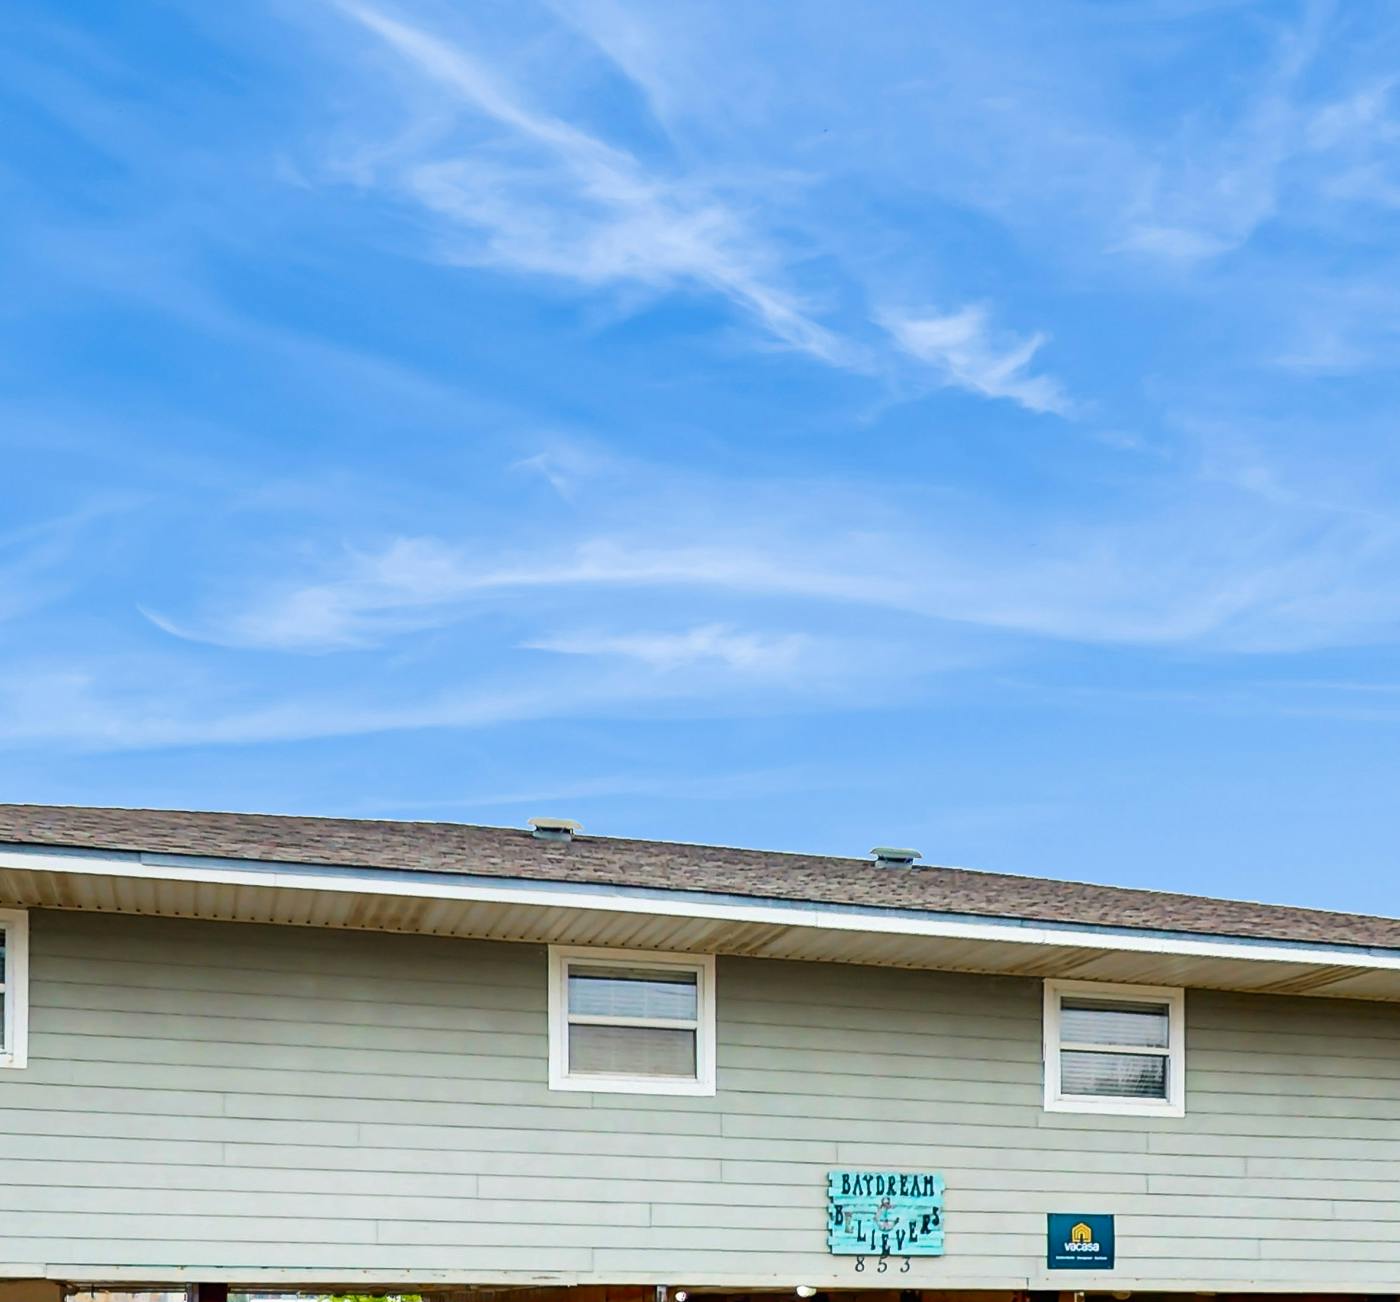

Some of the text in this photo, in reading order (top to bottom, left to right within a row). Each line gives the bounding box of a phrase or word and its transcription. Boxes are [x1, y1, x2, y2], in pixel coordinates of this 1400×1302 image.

[842, 1173, 934, 1197] BAYDREAM
[834, 1205, 940, 1254] BELIEVERS
[1064, 1242, 1100, 1252] vacasa
